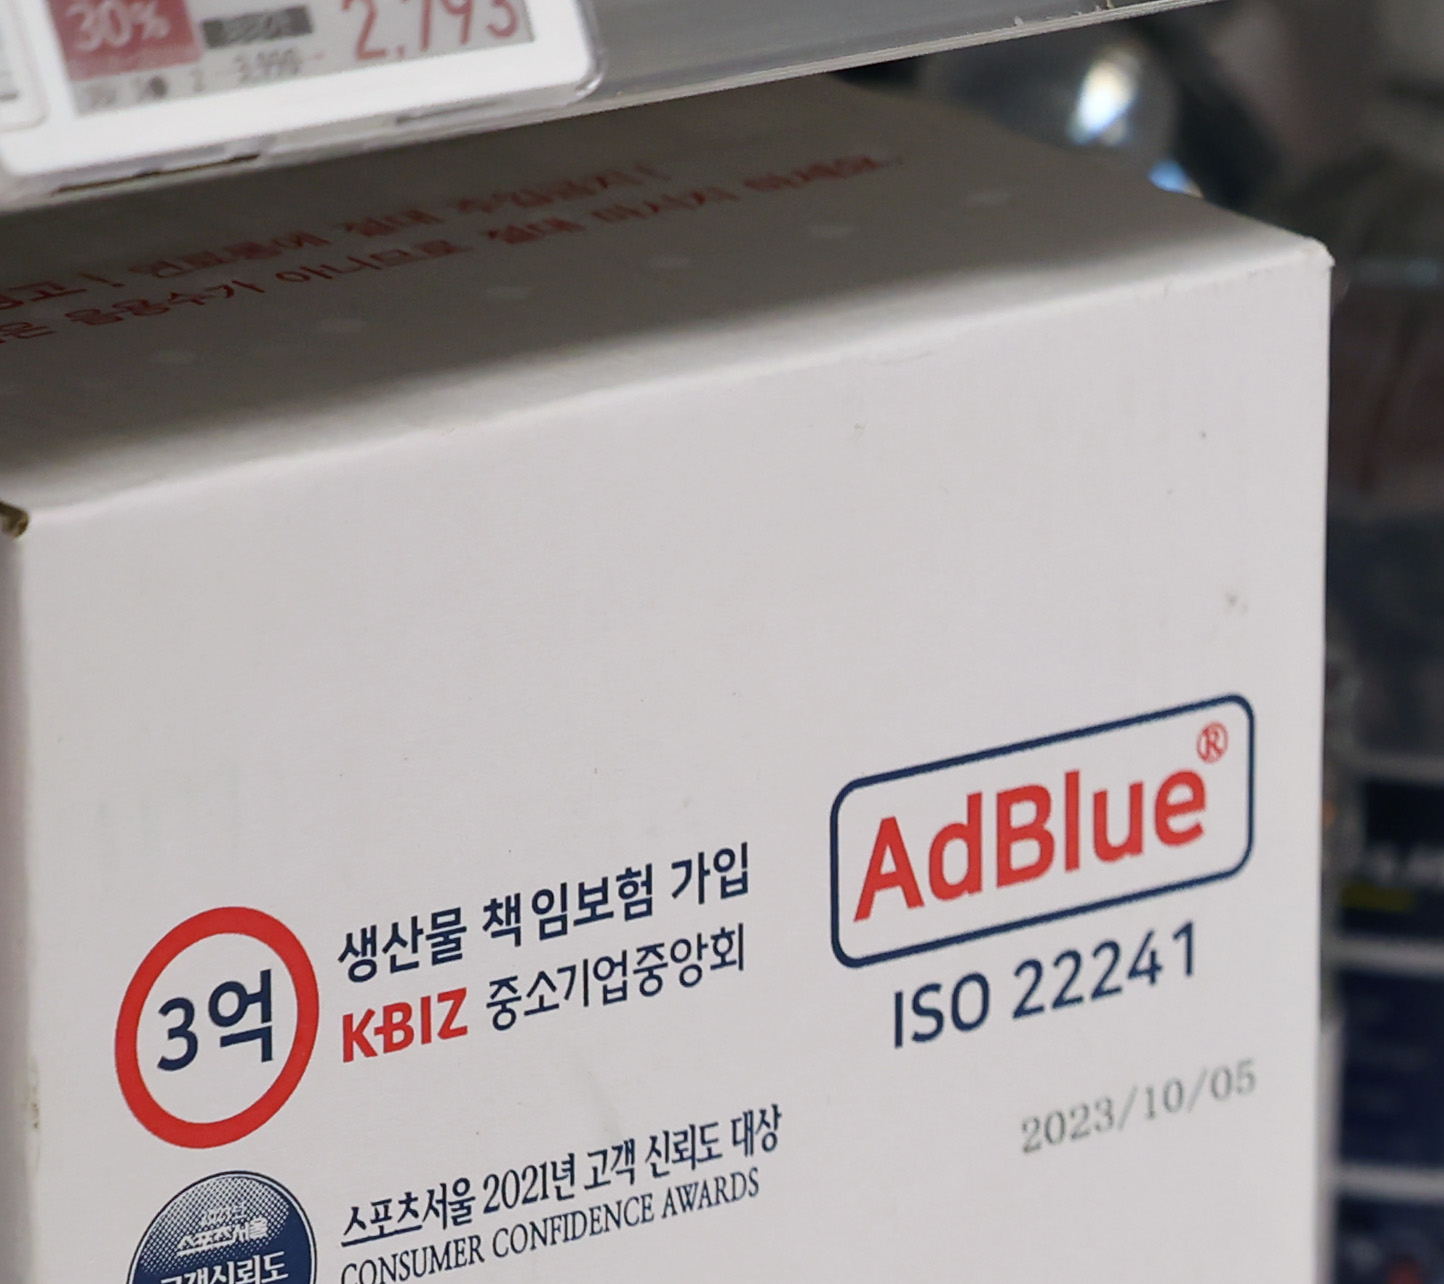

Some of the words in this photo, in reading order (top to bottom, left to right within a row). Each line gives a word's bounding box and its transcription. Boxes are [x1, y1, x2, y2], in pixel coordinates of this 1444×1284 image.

[337, 905, 467, 984] 생산물
[670, 842, 751, 906] 가입
[157, 968, 275, 1073] 3억
[485, 923, 745, 1032] 중소기업중앙회
[894, 971, 991, 1049] ISO
[1012, 920, 1196, 1020] 22241
[1020, 1058, 1258, 1155] 2023/10/05
[340, 1176, 476, 1249] 스포츠서울
[483, 1151, 577, 1216] 2021년
[584, 1141, 637, 1192] 고객
[645, 1120, 724, 1182] 신뢰도
[731, 1103, 783, 1159] 대상
[491, 1191, 656, 1261] CONFIDENCE
[660, 1165, 761, 1220] AWARDS
